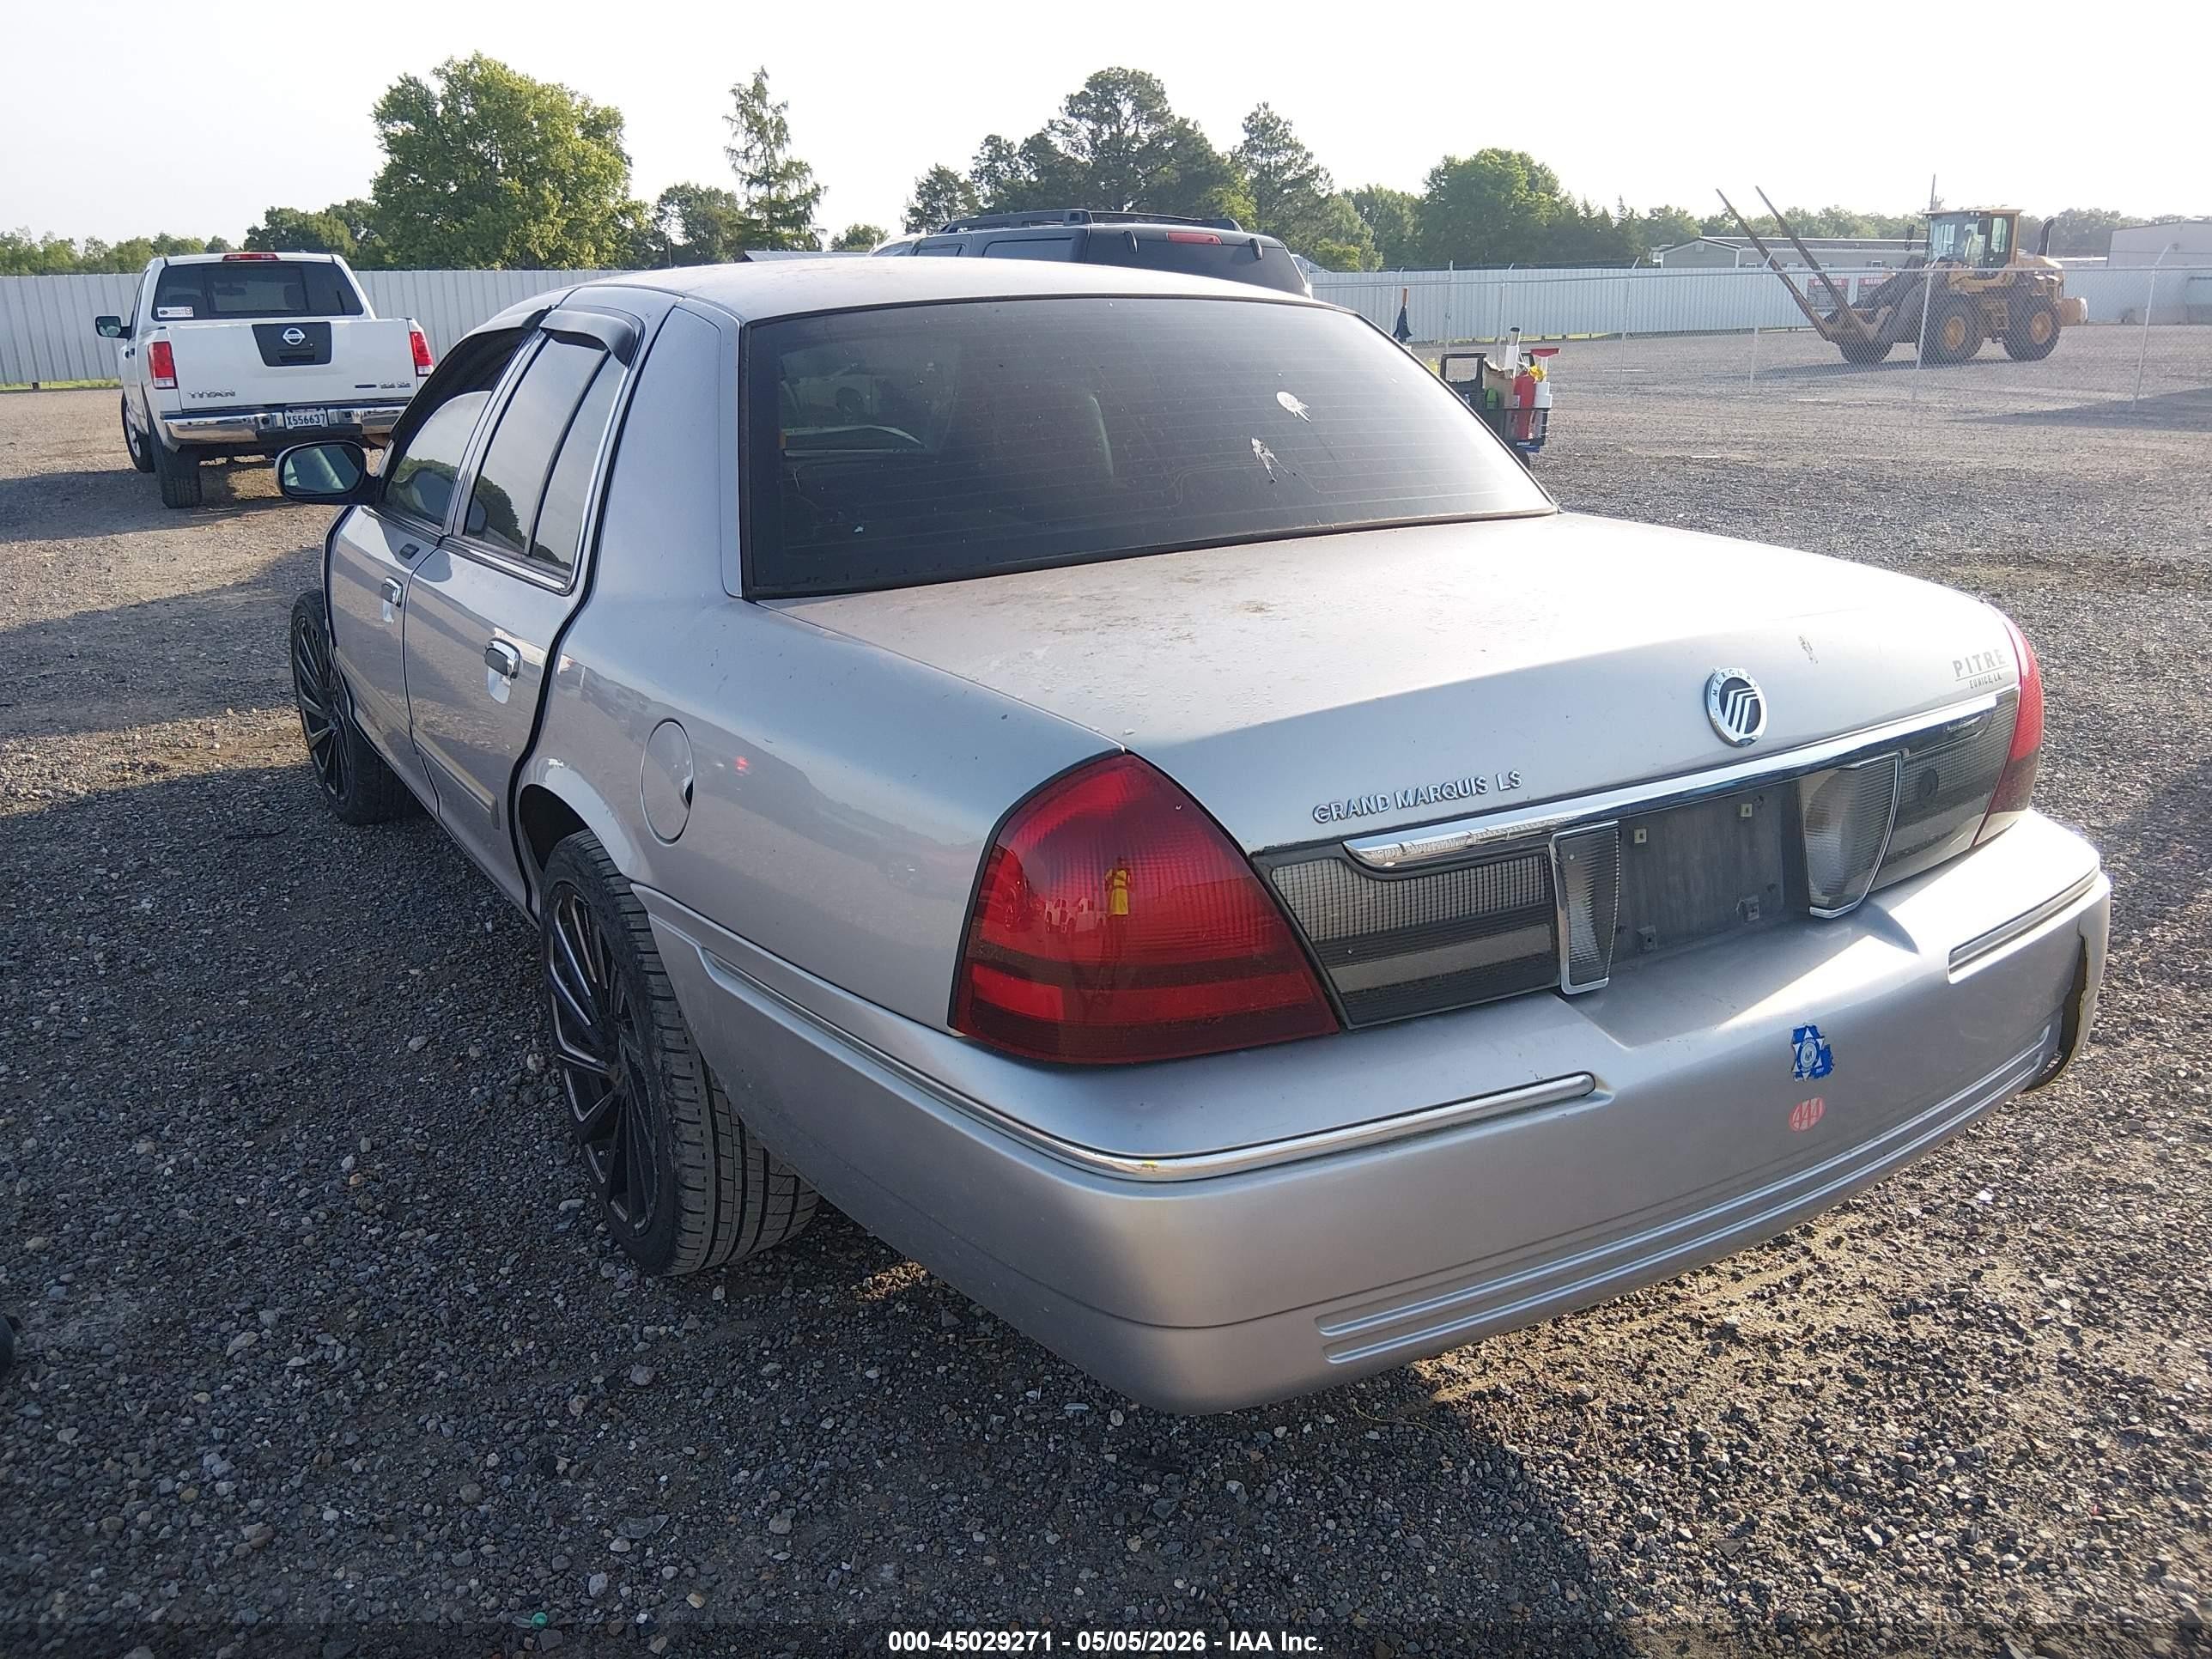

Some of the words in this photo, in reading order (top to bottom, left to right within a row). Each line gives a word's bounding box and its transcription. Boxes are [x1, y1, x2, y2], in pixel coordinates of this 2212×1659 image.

[186, 390, 235, 398] TITAN
[286, 413, 325, 426] X556637
[1952, 649, 2006, 678] PITRE
[1312, 793, 1391, 823] GRAND
[1395, 775, 1490, 810] MARQUIS
[1495, 769, 1523, 792] LS
